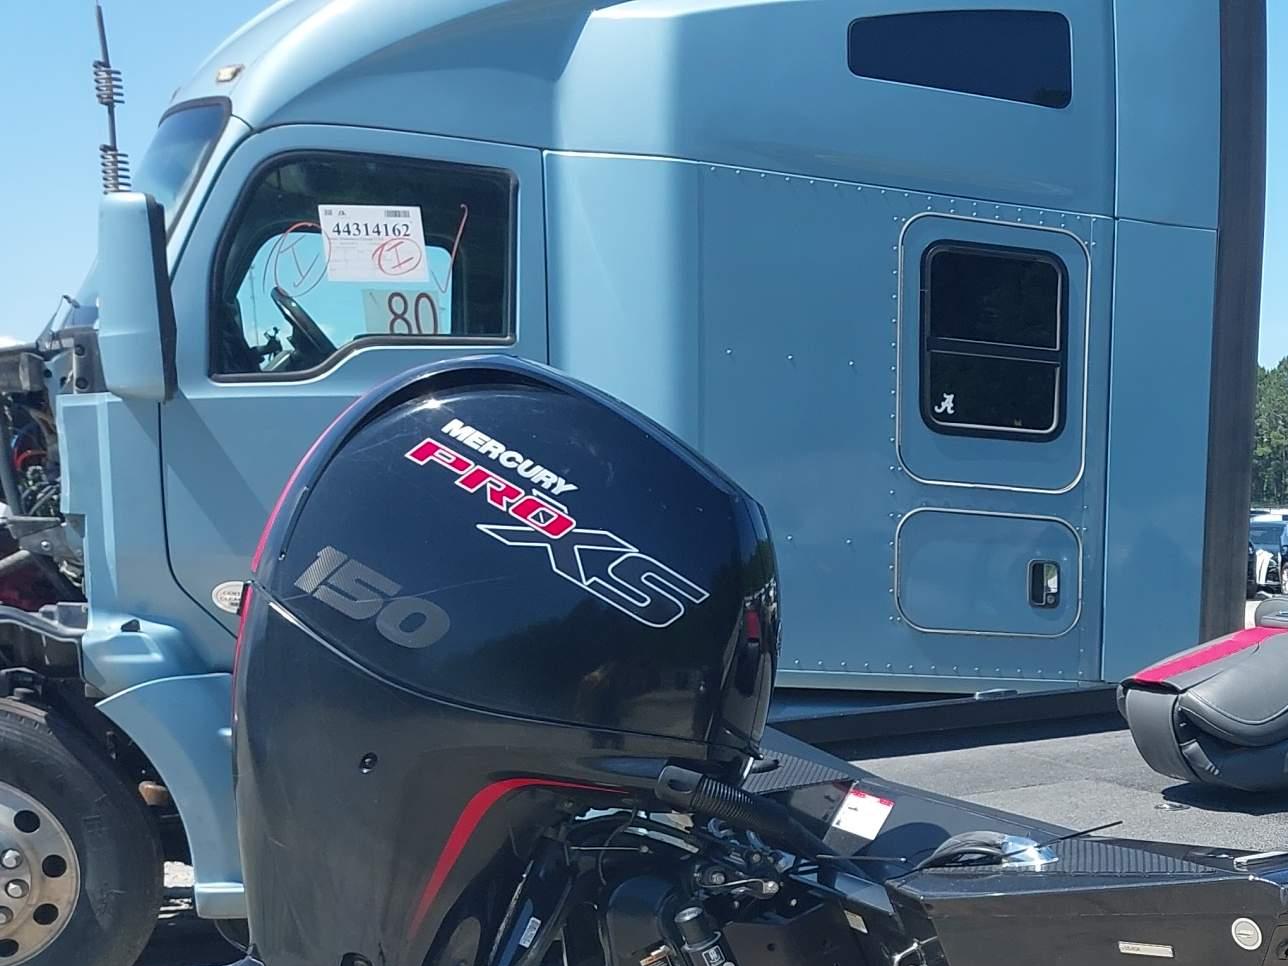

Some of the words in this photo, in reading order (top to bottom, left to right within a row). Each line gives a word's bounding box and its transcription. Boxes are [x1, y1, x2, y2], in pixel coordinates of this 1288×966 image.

[332, 222, 411, 237] 44314162
[387, 292, 439, 334] 80
[404, 437, 577, 539] PRO
[441, 418, 579, 495] MERCURY
[294, 545, 450, 649] 150
[476, 489, 710, 628] XS
